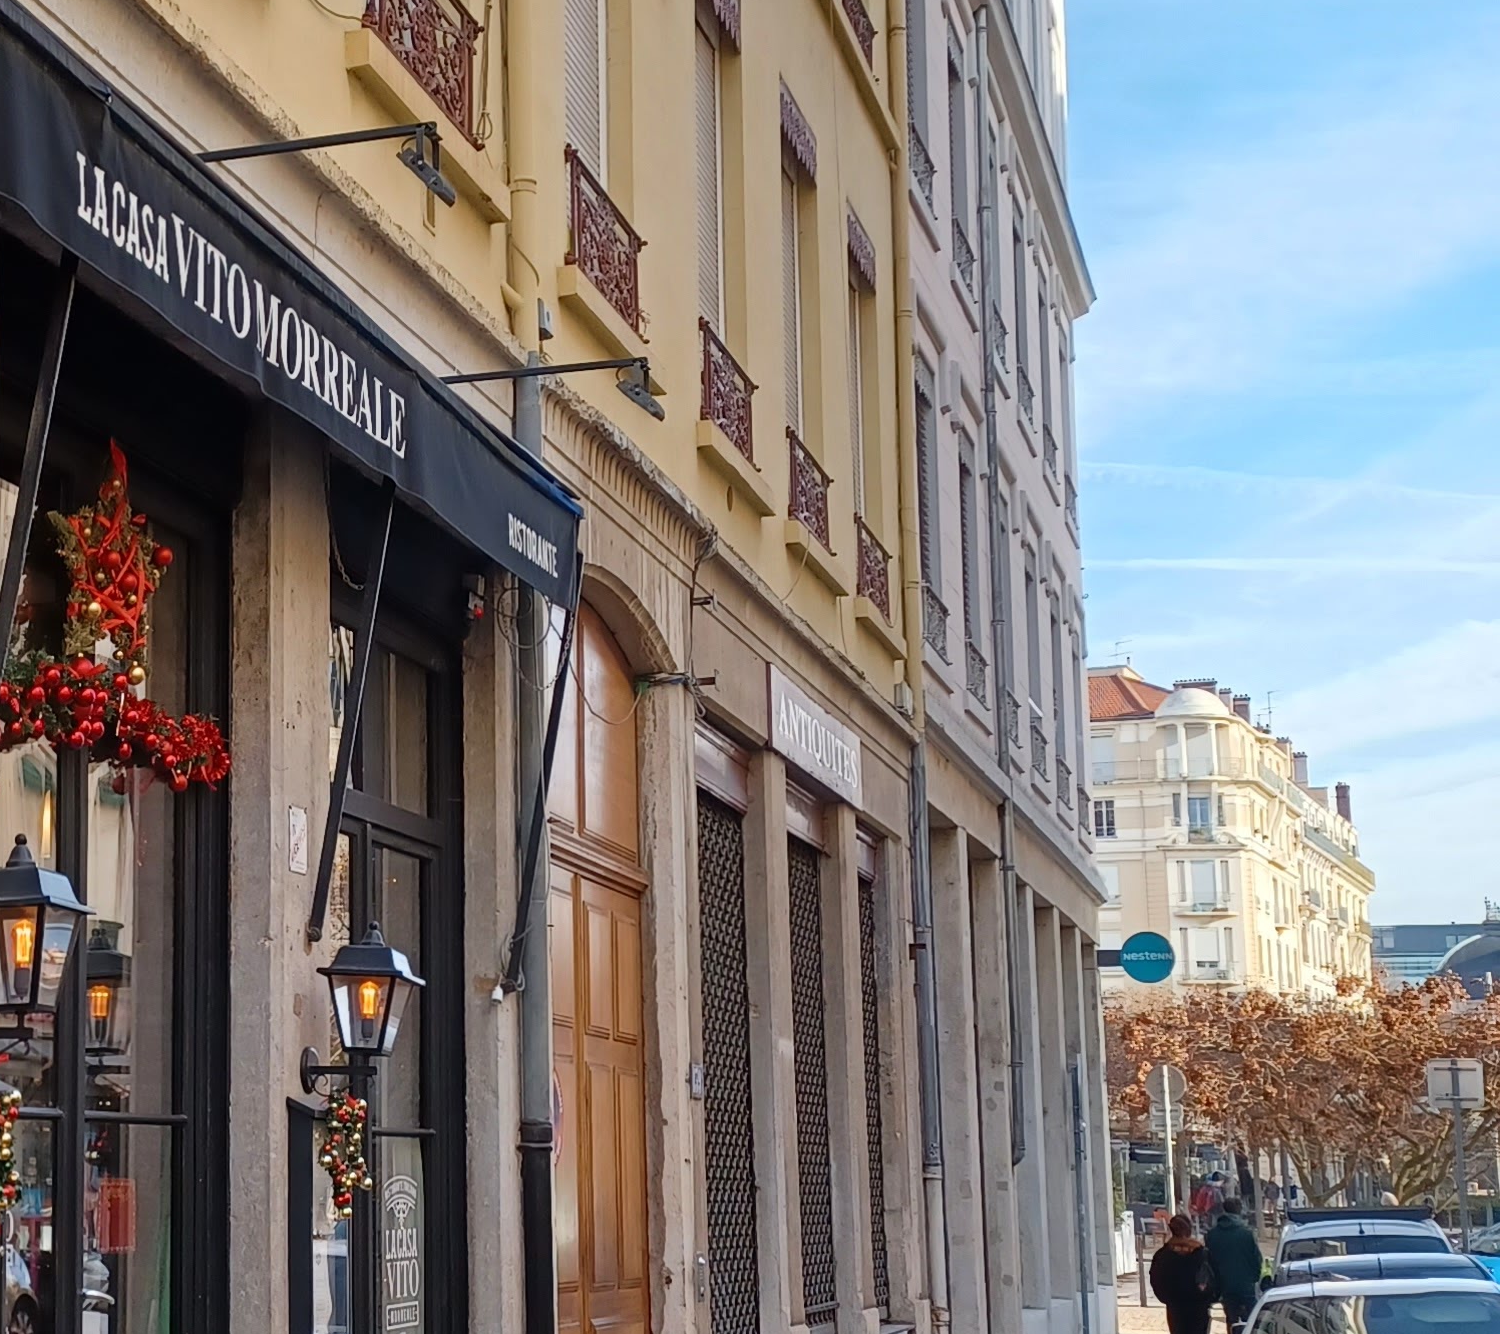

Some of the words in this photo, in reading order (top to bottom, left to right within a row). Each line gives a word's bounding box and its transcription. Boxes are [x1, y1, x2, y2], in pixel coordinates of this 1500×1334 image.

[170, 212, 251, 339] VITO
[253, 278, 406, 459] MORREALE
[507, 512, 559, 579] RISTORANTE
[778, 691, 858, 788] ANTIQUITES
[386, 1259, 420, 1300] VITO
